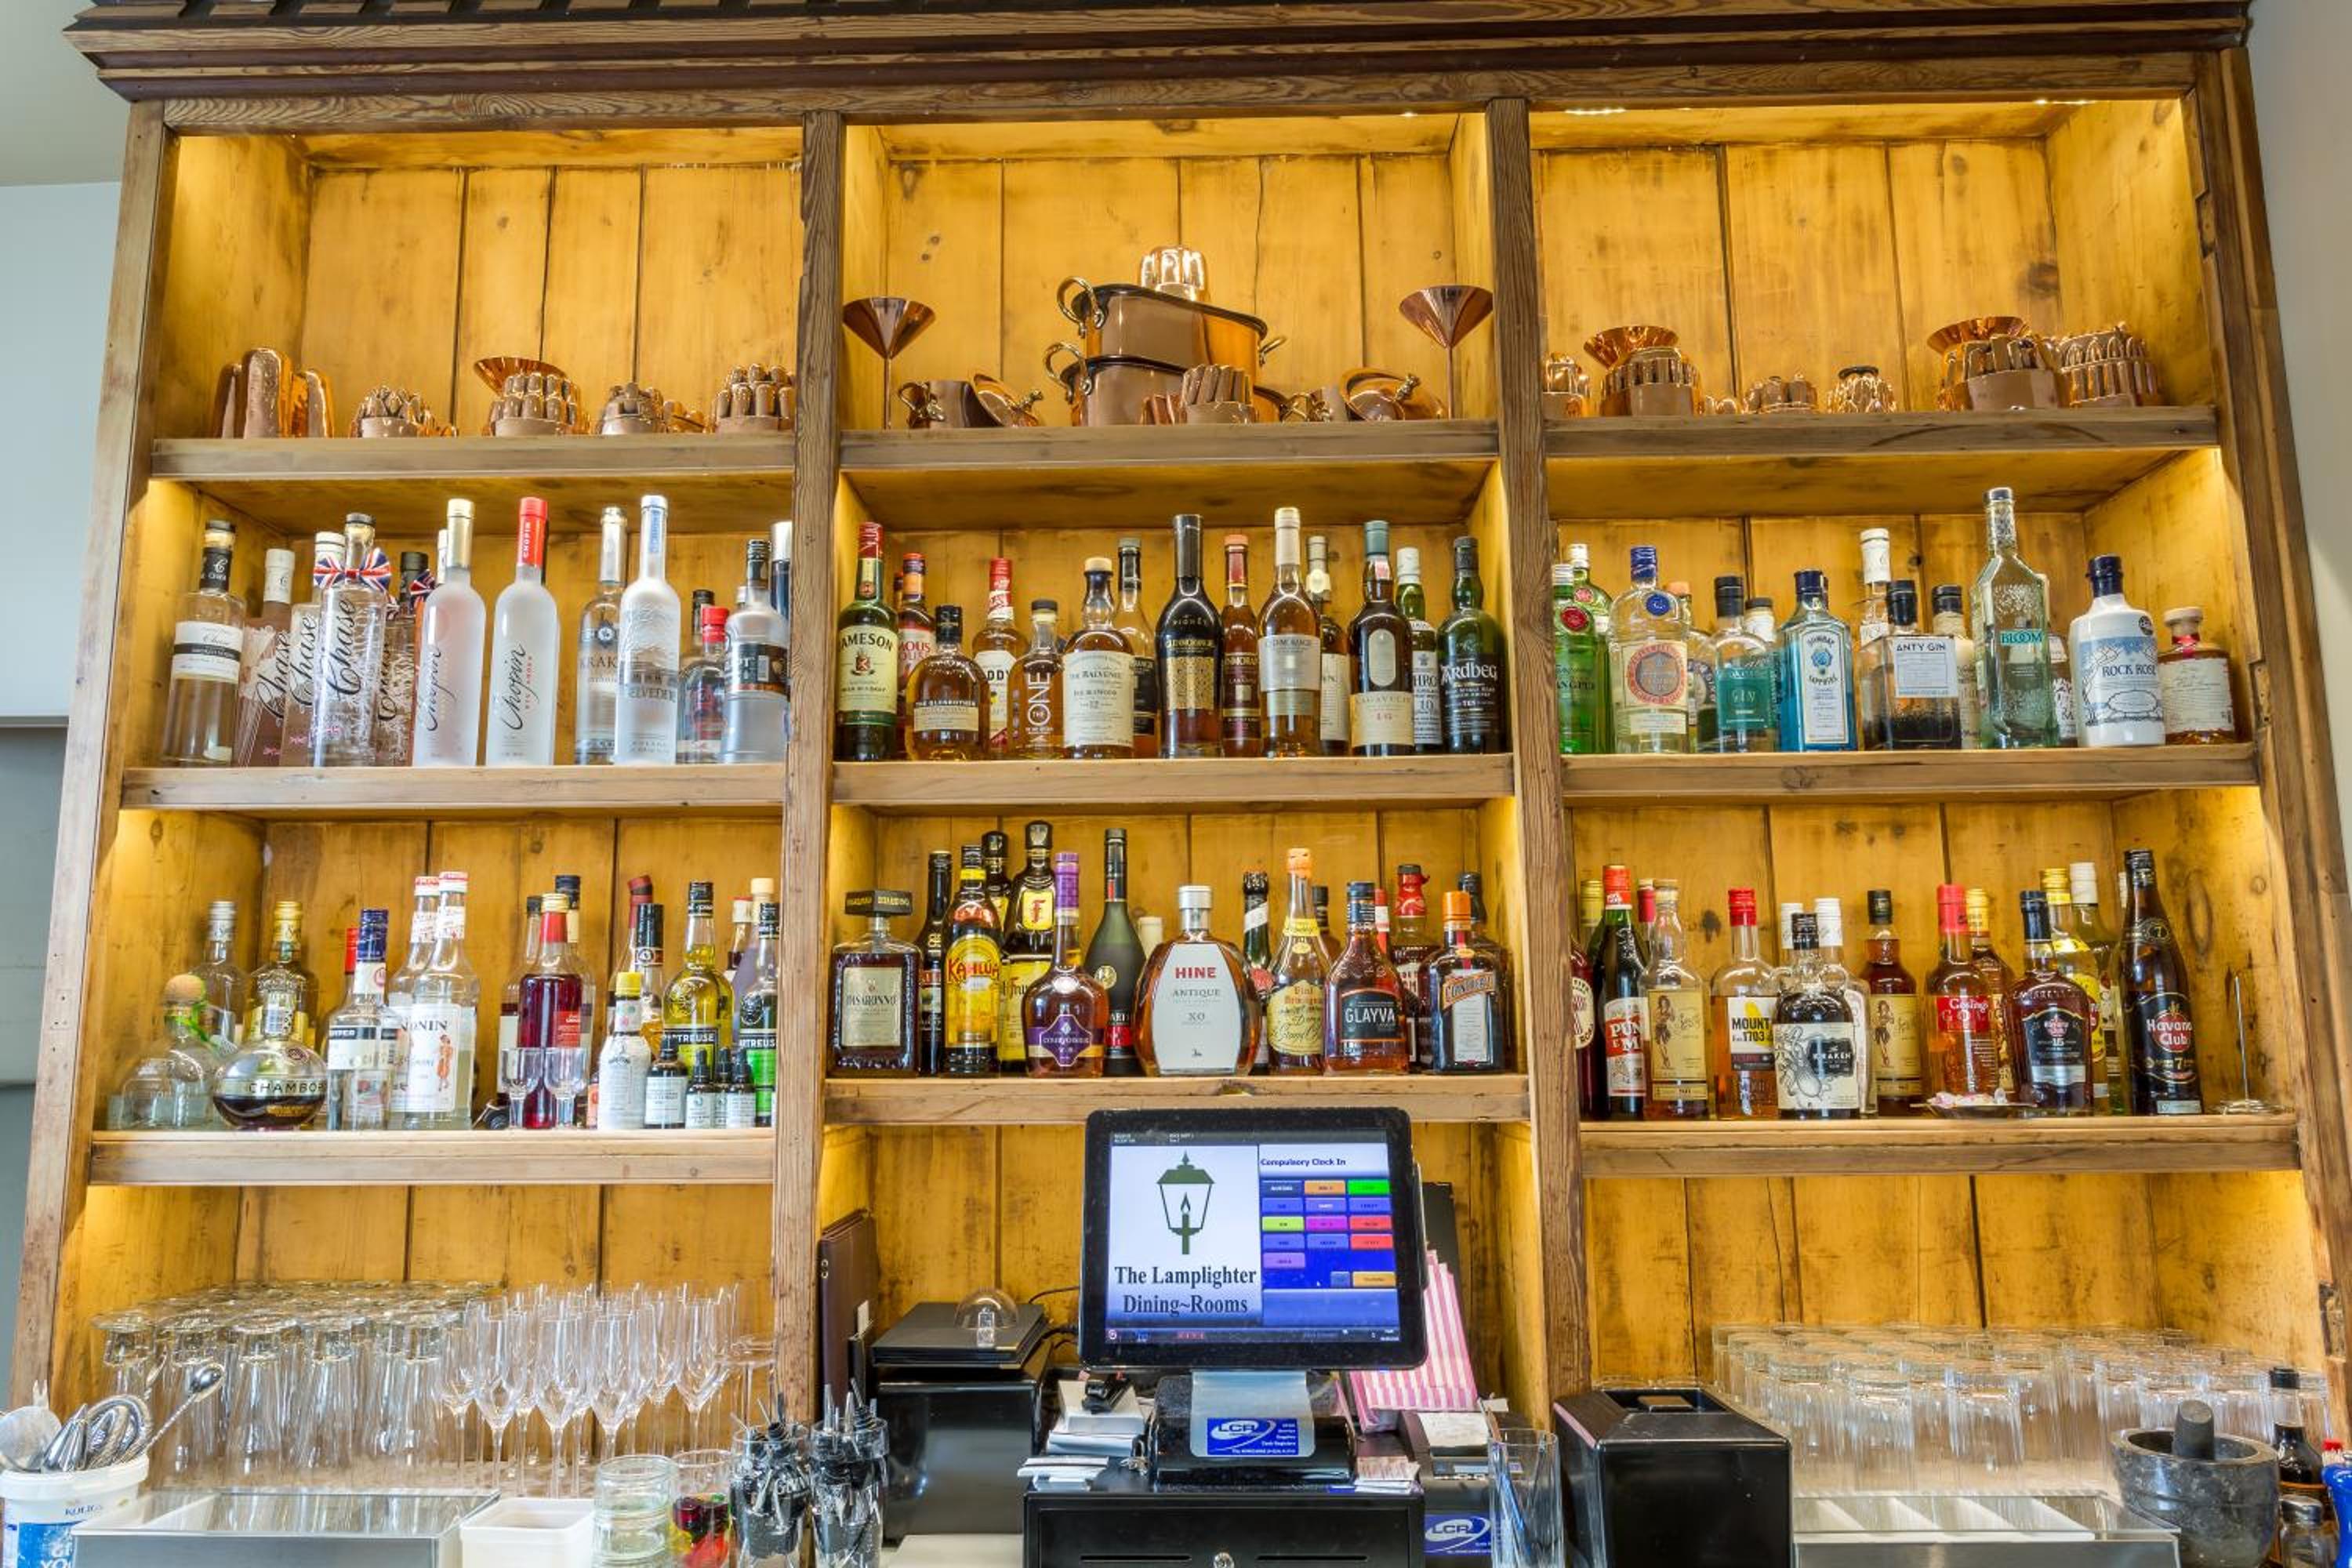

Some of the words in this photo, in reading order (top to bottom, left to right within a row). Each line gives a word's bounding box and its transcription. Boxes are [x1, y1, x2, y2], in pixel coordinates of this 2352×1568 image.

[2001, 631, 2043, 644] BLOOM
[327, 599, 361, 695] Chase
[1896, 643, 1925, 652] ANTY
[1928, 642, 1947, 651] GIN
[2101, 664, 2134, 677] ROCK
[502, 641, 540, 731] Chopin
[1175, 967, 1217, 978] HINE
[1172, 989, 1221, 998] ANTIQUE
[1344, 1007, 1396, 1024] GLAYVA
[1731, 1017, 1769, 1030] MOUNT
[2146, 1018, 2193, 1034] Havana
[2158, 1031, 2189, 1046] Club
[248, 1082, 325, 1094] CHAMBOR
[1260, 1158, 1309, 1168] Compulsory
[1312, 1157, 1334, 1167] Clock
[1336, 1158, 1346, 1167] In
[1114, 1265, 1147, 1284] The
[1152, 1265, 1258, 1289] Lamplighter
